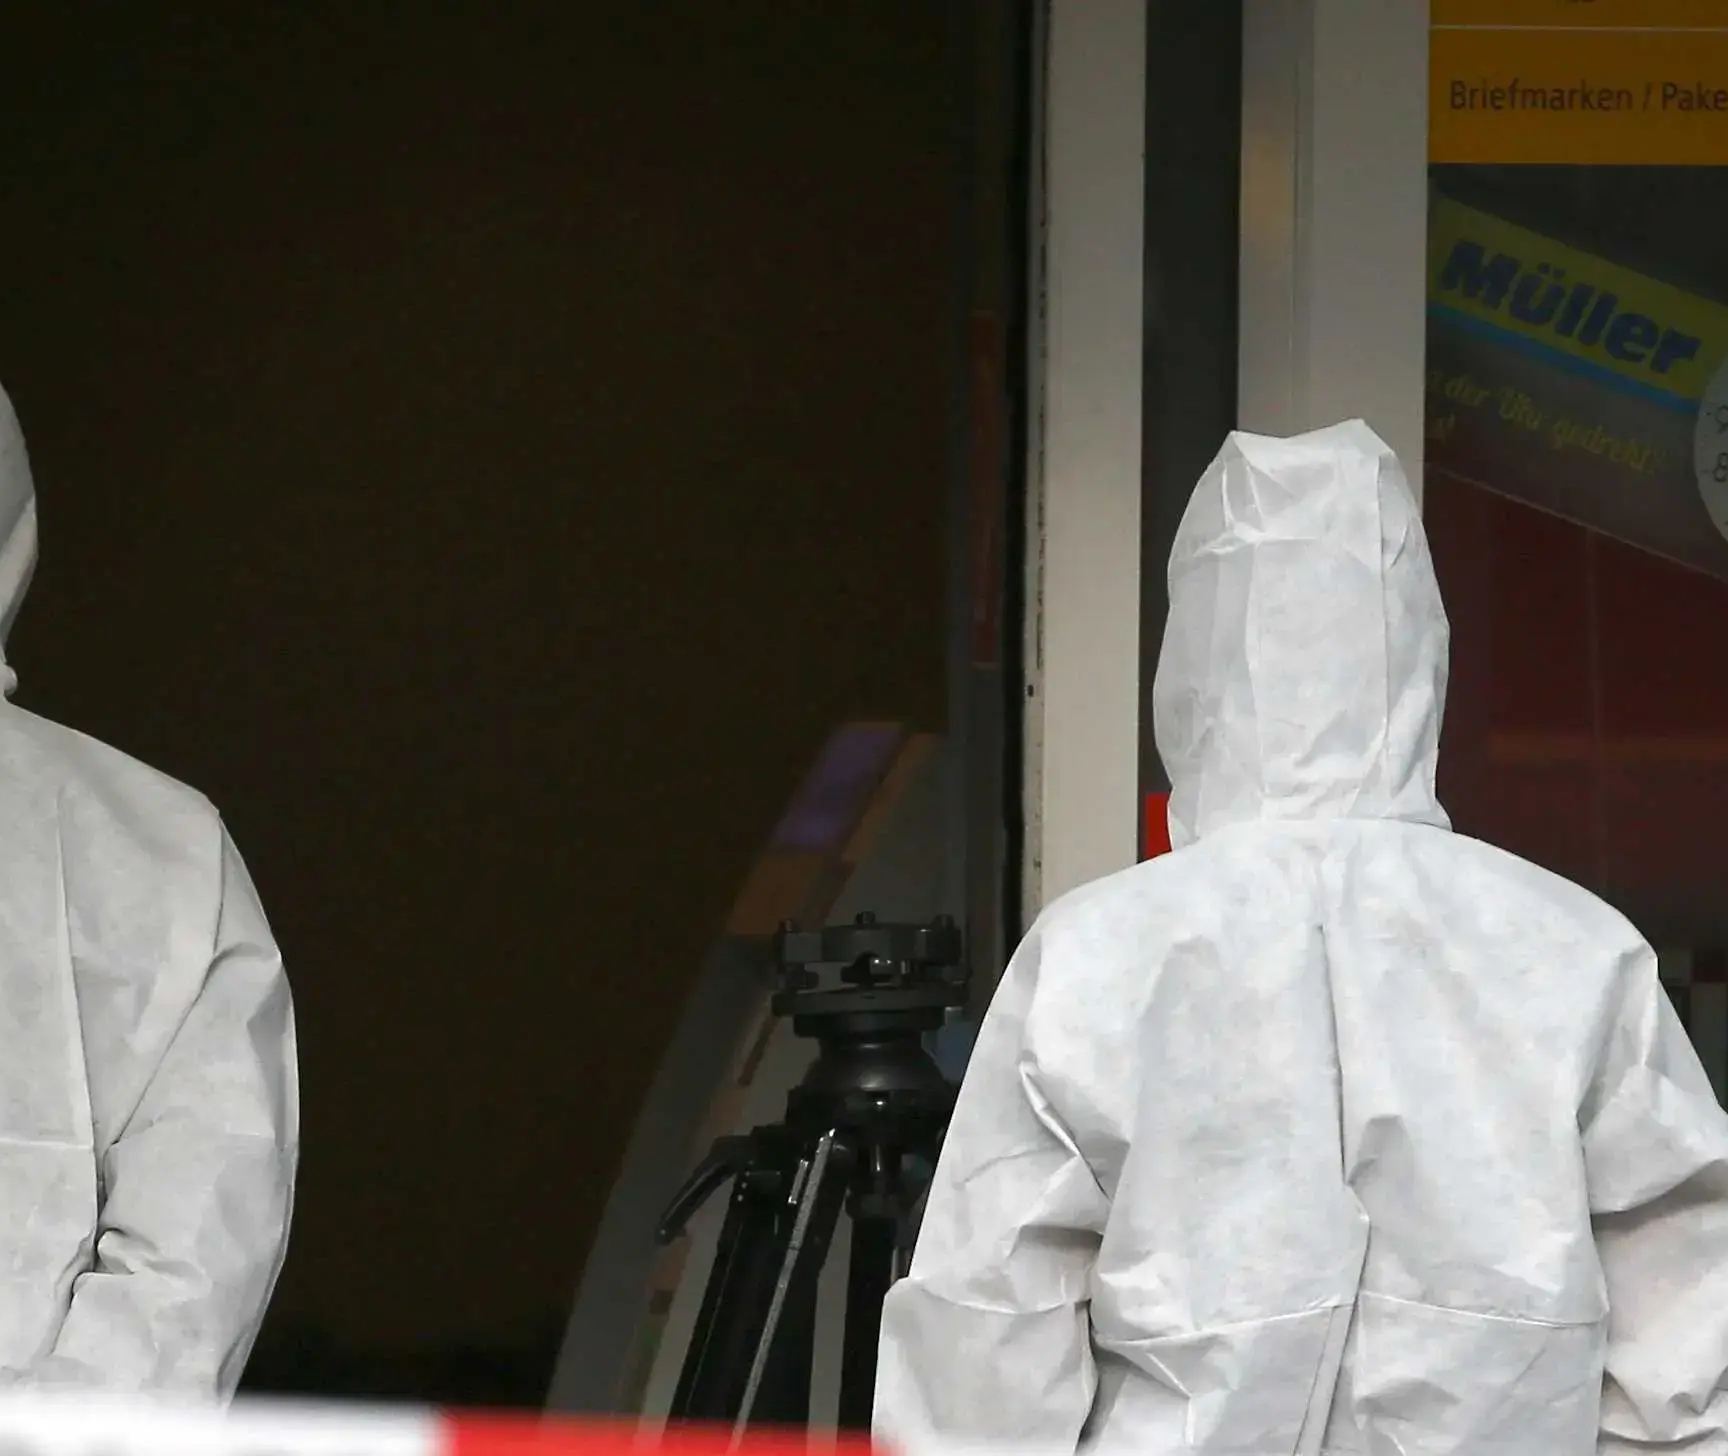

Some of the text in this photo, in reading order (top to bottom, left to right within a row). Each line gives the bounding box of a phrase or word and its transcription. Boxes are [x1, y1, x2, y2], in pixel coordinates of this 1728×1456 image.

[1450, 78, 1633, 112] Briefmarken
[1642, 82, 1652, 112] /
[1438, 240, 1704, 375] Müller
